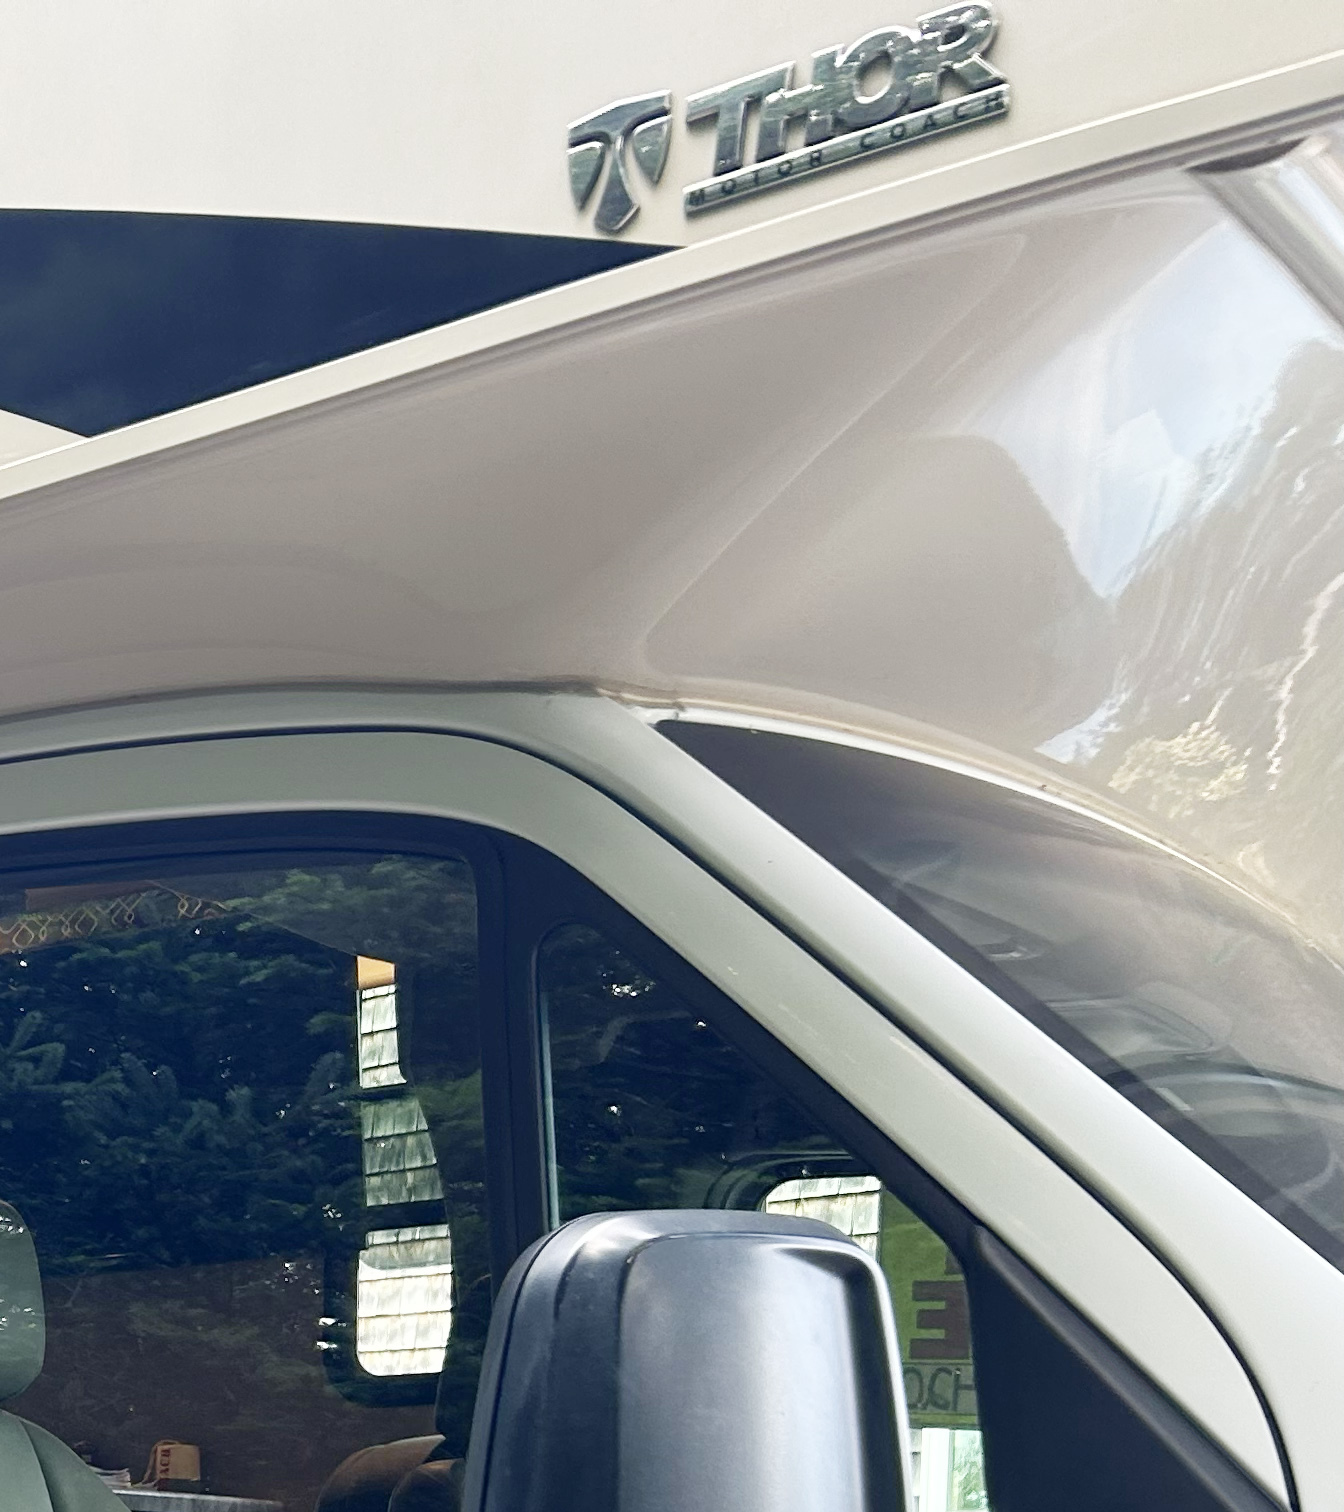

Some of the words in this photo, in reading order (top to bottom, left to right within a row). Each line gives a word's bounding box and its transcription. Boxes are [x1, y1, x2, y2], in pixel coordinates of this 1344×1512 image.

[685, 1, 1007, 177] THOR
[687, 149, 823, 206] MOTOR
[859, 89, 1005, 149] COACH
